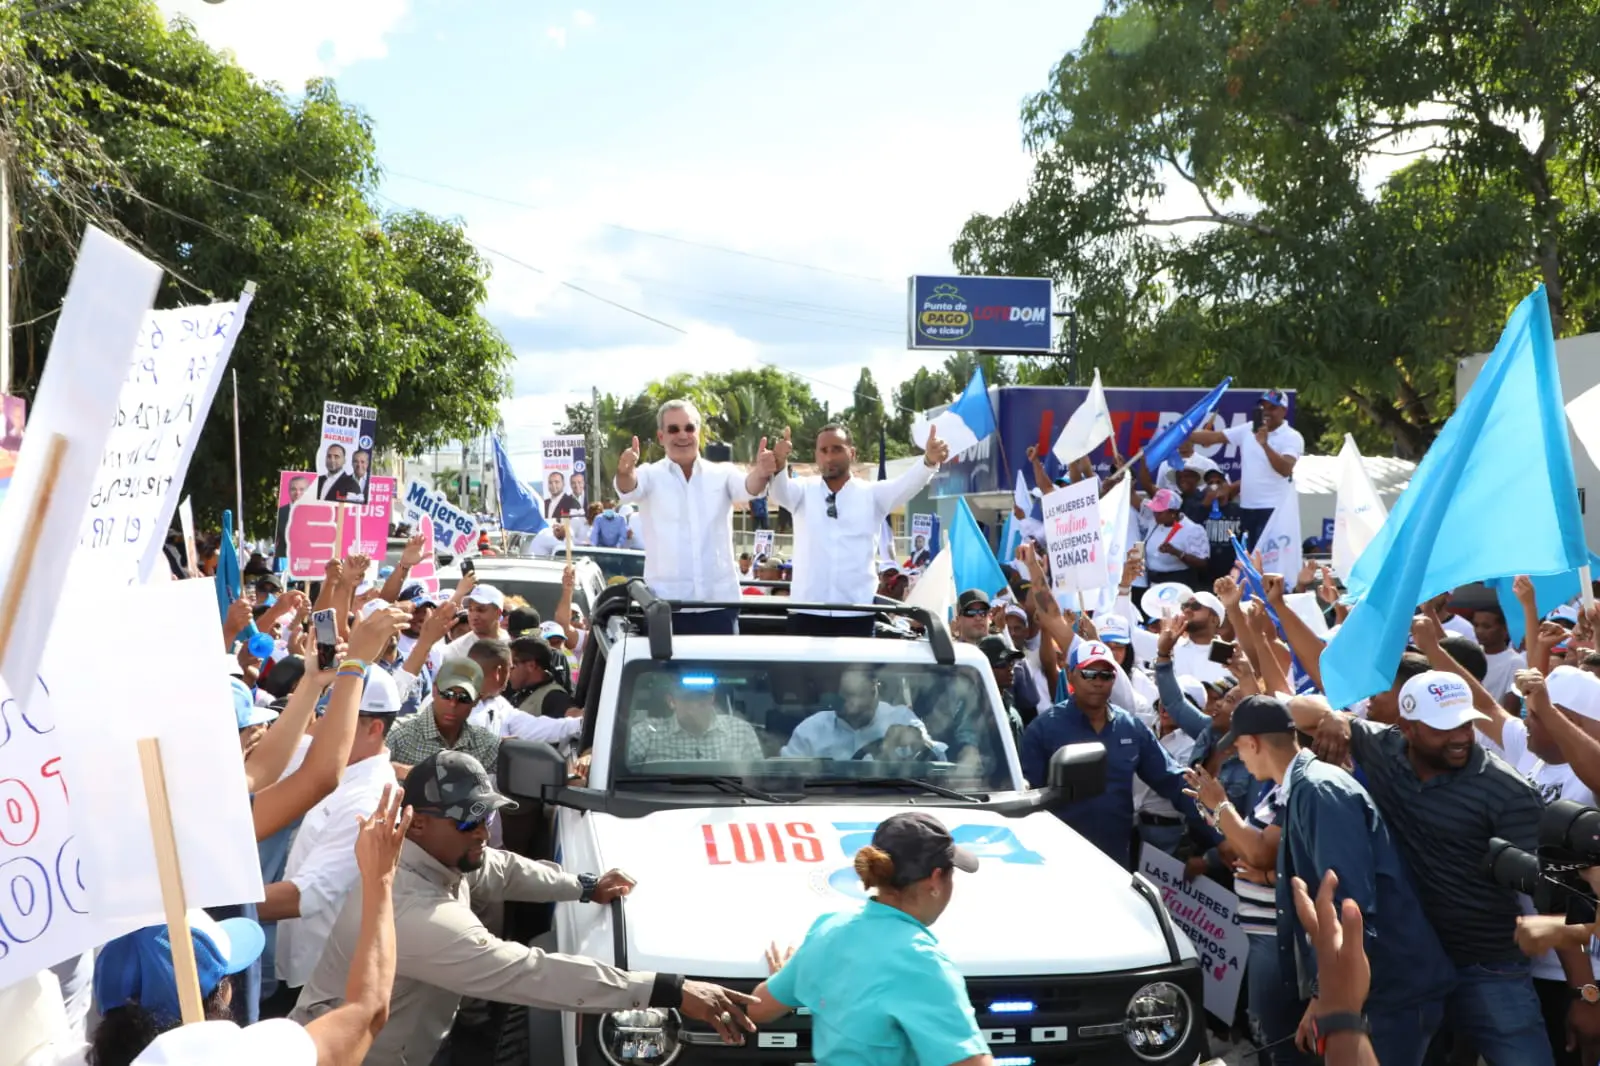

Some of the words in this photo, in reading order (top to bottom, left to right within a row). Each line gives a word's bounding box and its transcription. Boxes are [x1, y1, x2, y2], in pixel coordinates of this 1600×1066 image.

[924, 302, 953, 311] Punto
[955, 302, 967, 311] de
[973, 305, 1046, 322] LOTEDOM
[927, 312, 964, 324] PAGO
[926, 326, 937, 335] de
[939, 326, 964, 335] ticket
[326, 403, 353, 416] SECTOR
[354, 408, 376, 420] SALUD
[326, 414, 359, 428] CON
[542, 440, 566, 448] SECTOR
[544, 448, 571, 457] CON
[407, 481, 473, 535] Mujeres
[1045, 507, 1056, 519] LAS
[1056, 498, 1085, 515] MUJERES
[1085, 494, 1097, 506] DE
[1050, 532, 1093, 552] VOLVEREMOS
[1093, 530, 1100, 541] A
[1056, 548, 1089, 568] GANAR
[701, 822, 825, 865] LUIS
[1145, 862, 1169, 884] LAS
[1172, 878, 1230, 919] MUJERES
[1228, 956, 1239, 970] A
